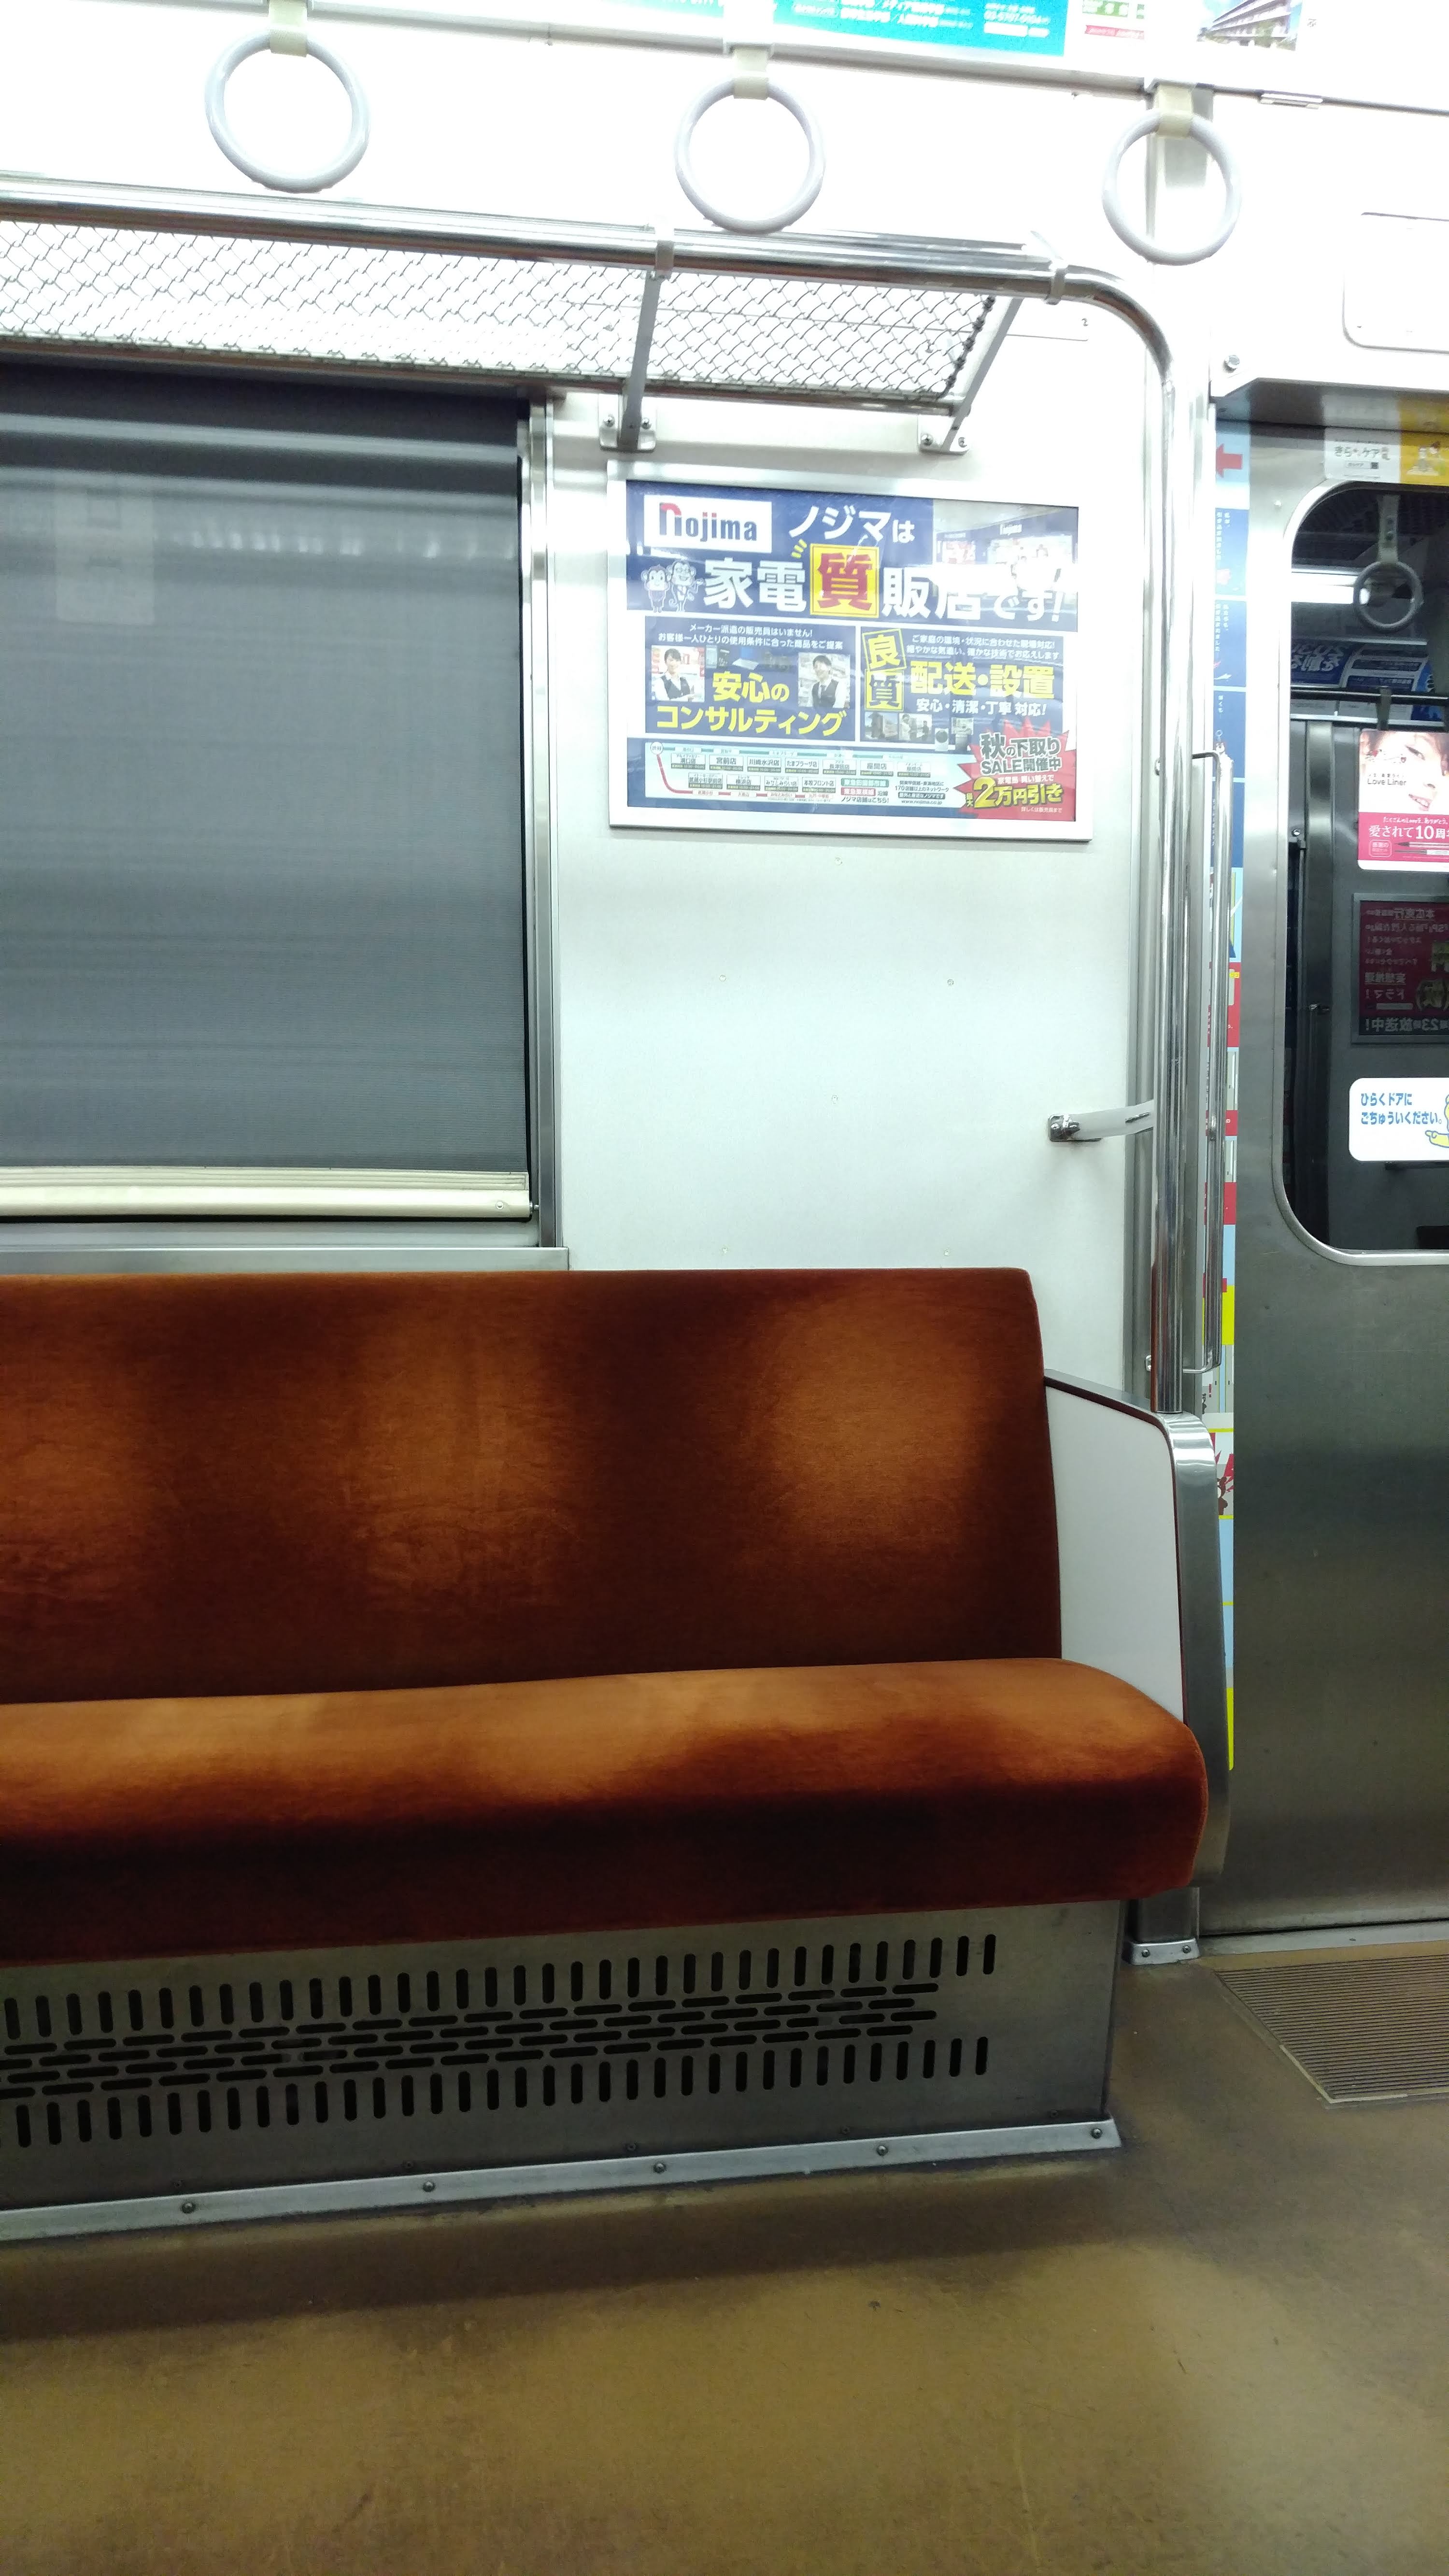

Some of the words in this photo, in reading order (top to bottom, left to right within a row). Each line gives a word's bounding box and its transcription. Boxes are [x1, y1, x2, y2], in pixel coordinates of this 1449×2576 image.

[789, 505, 915, 543] ノジマは
[712, 671, 790, 703] 安心の
[910, 660, 1054, 699] 配送・設置
[657, 705, 847, 736] コンサルティング
[716, 756, 737, 765] 宮前店
[980, 733, 1061, 760] 秋の下取り
[981, 756, 1062, 774] SALE開催中
[973, 777, 1064, 809] 2万円引き
[1361, 1093, 1412, 1106] ひらくドアに
[1361, 1111, 1442, 1124] ごちゅういください。
